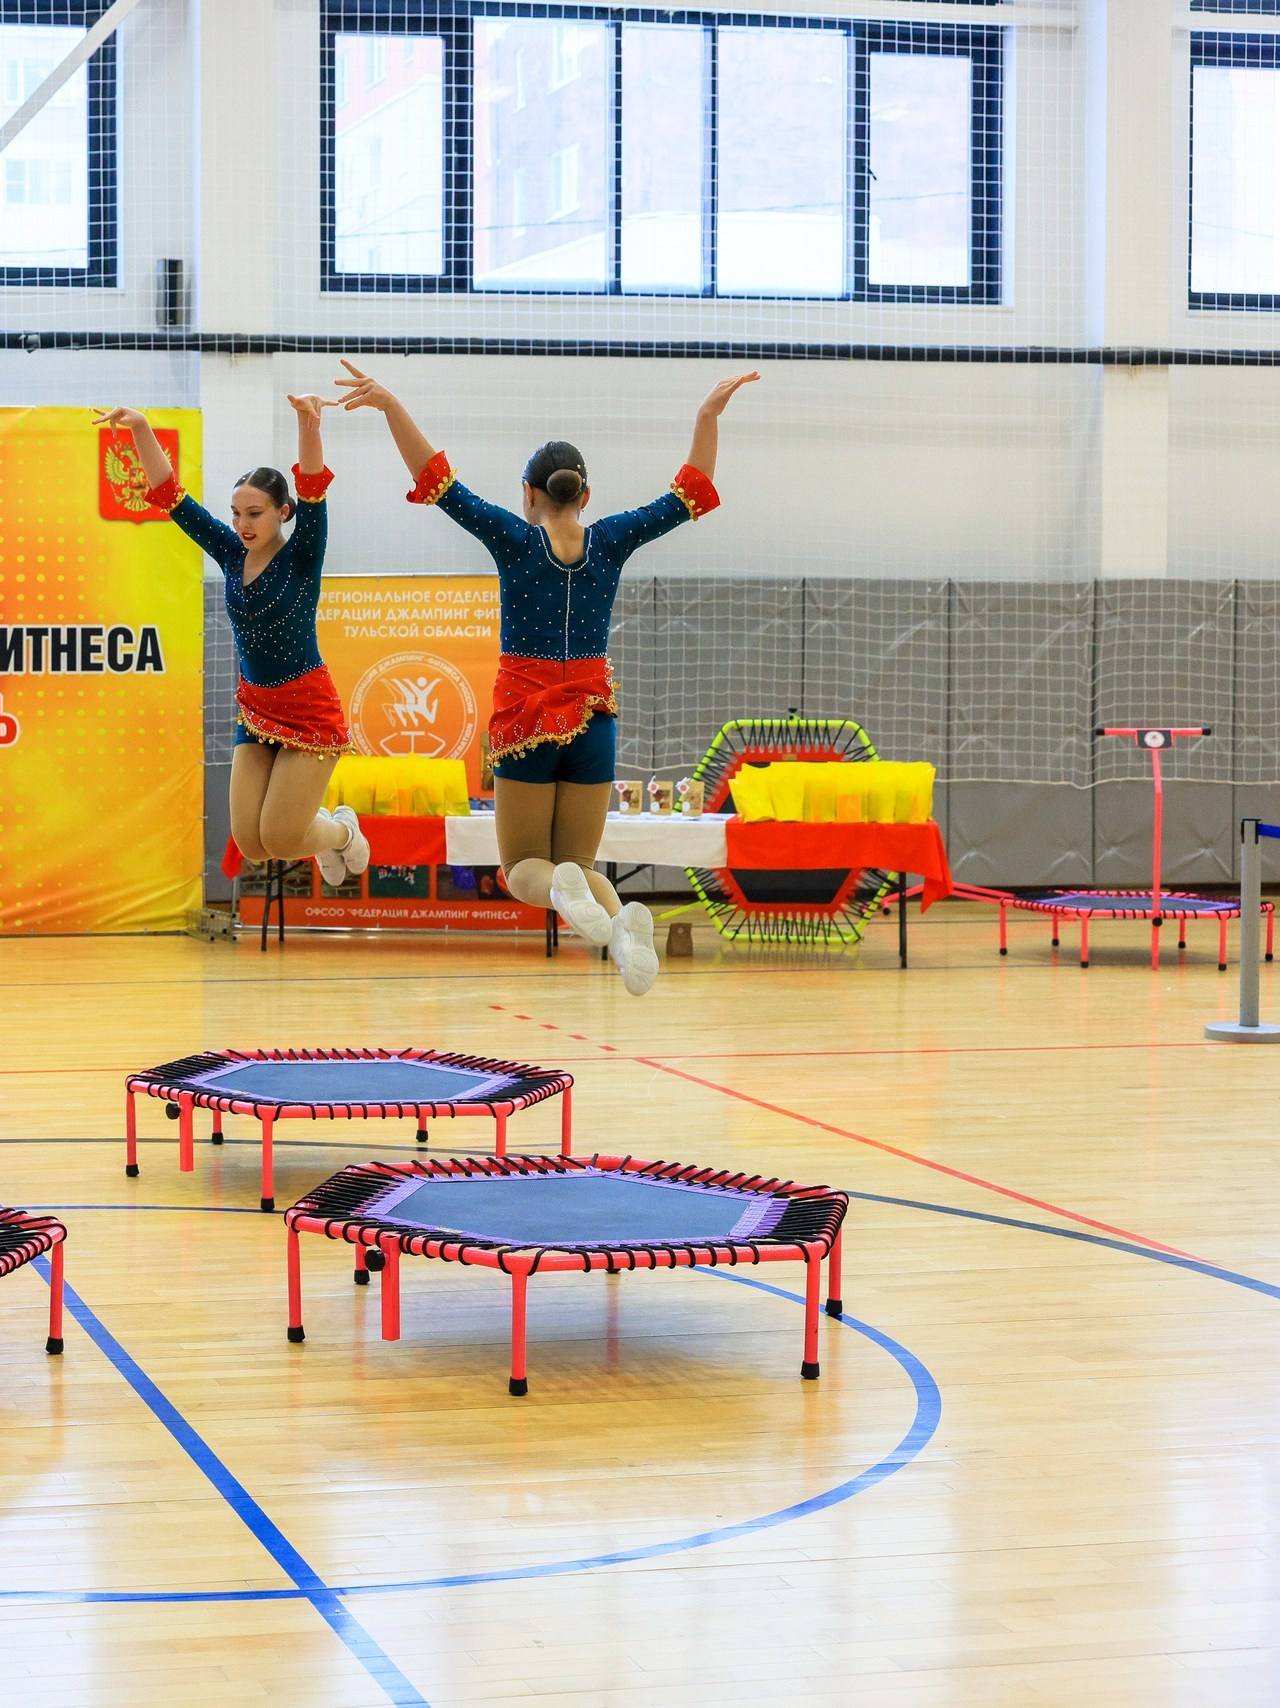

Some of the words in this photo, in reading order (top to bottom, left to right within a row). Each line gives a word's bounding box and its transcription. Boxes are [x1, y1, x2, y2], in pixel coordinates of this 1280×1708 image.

[320, 590, 431, 604] РЕГИОНАЛЬНОЕ
[434, 590, 499, 605] ОТДЕЛЕН
[317, 608, 382, 621] ДЕРАЦИИ
[385, 608, 470, 621] ДЖАМПИНГ
[344, 622, 419, 638] ТУЛЬСКОЙ
[423, 625, 491, 638] ОБЛАСТИ
[305, 907, 345, 917] ОФСОО
[346, 908, 409, 919] "ФЕДЕРАЦИЯ
[411, 910, 470, 920] ДЖАМПИНГ
[472, 911, 522, 920] ФИТНЕСА"
